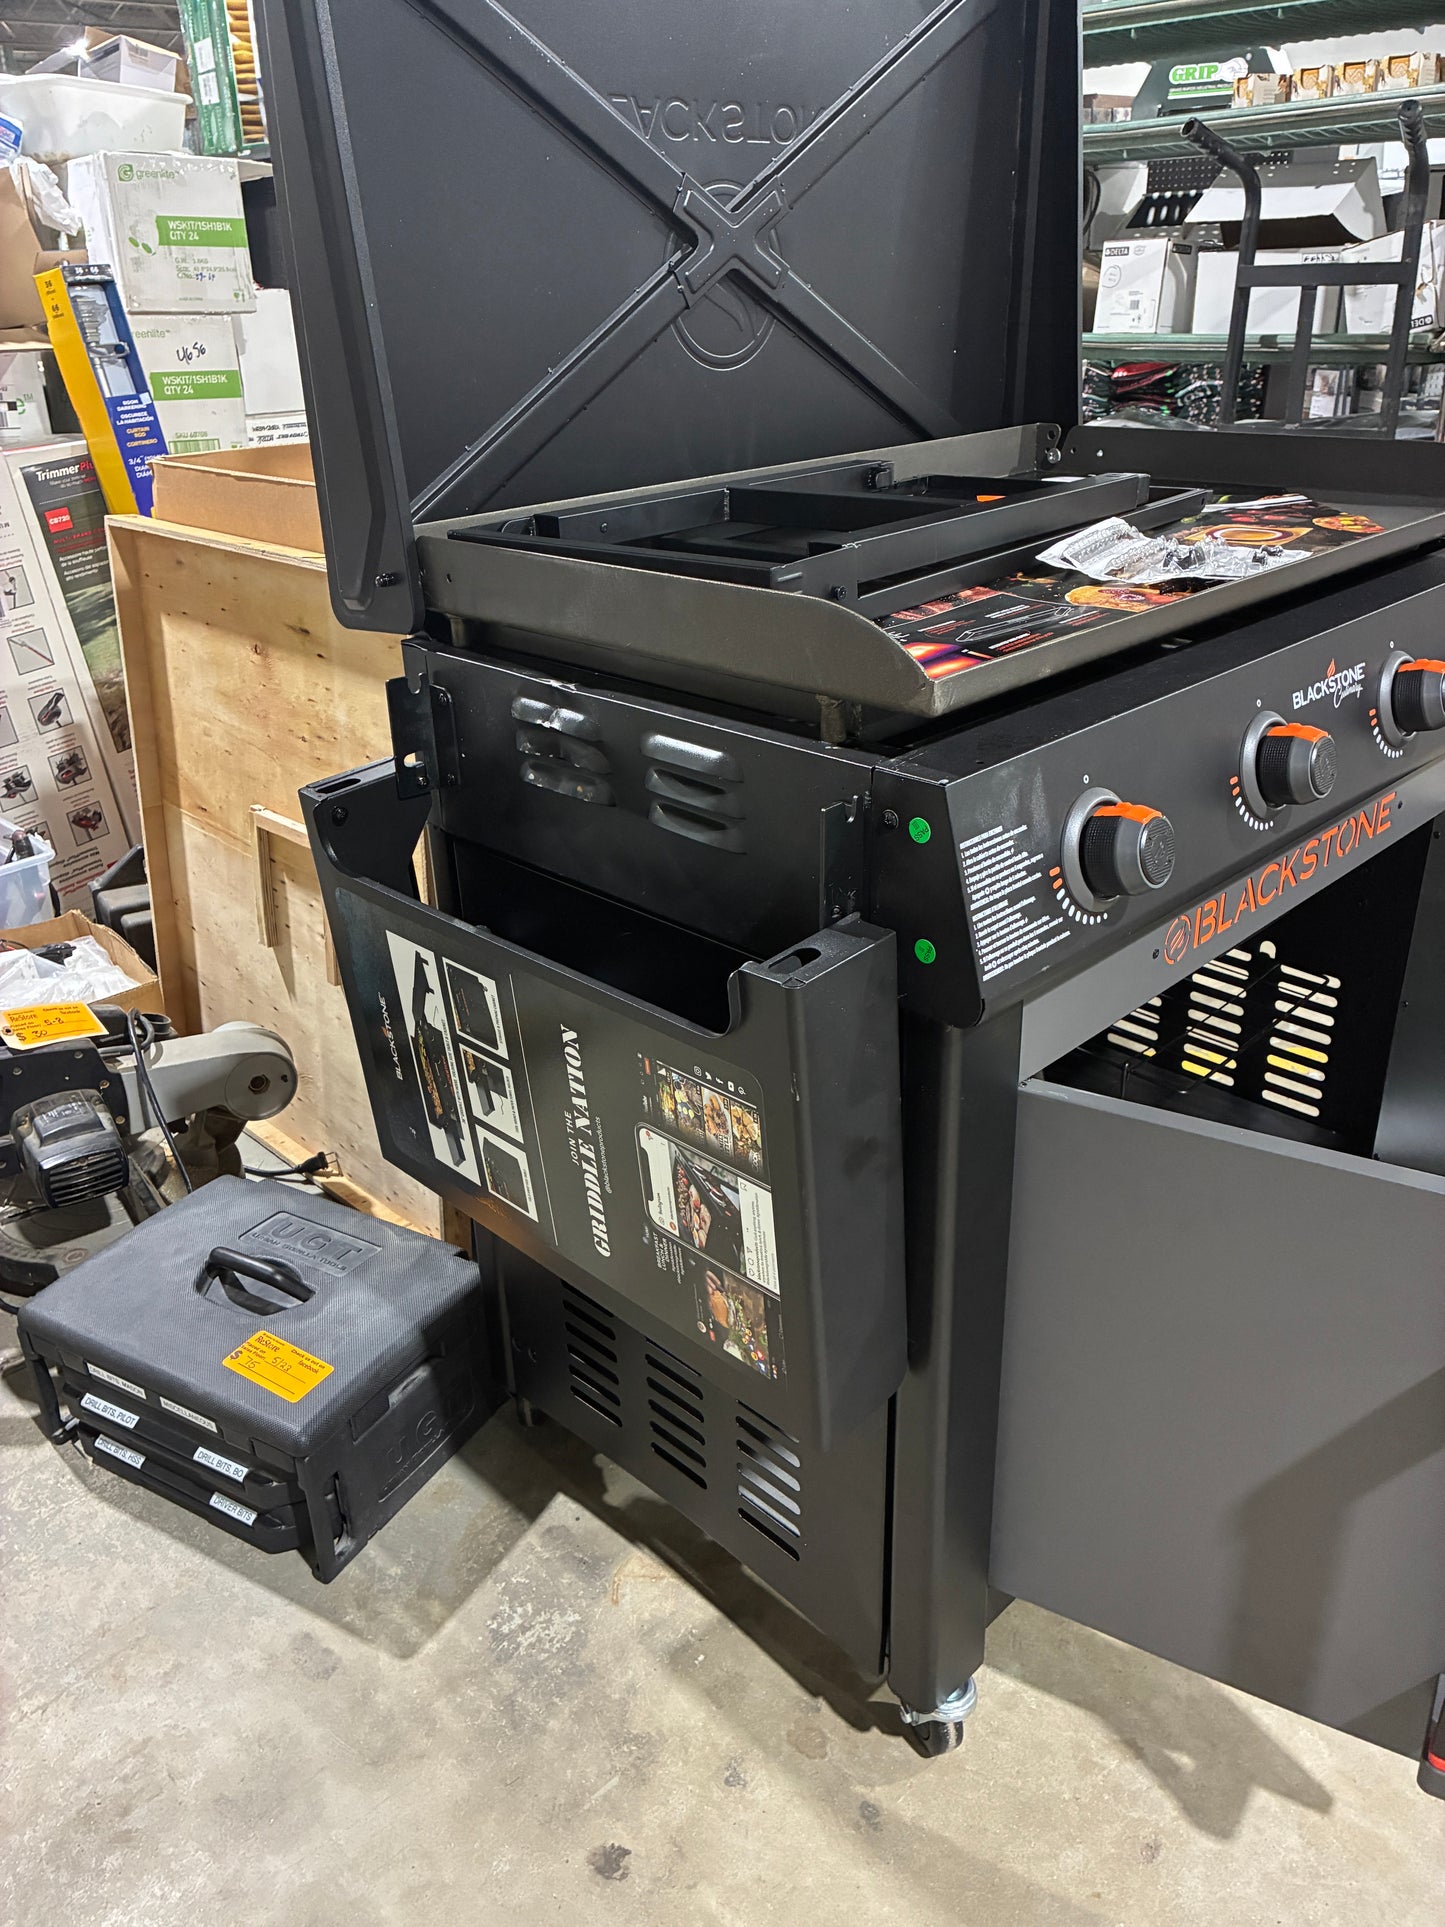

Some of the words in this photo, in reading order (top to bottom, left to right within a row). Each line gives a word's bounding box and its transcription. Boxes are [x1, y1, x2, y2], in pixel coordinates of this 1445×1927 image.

[1172, 64, 1219, 82] GRIP
[170, 231, 186, 241] QTY
[188, 231, 199, 240] 24
[1110, 247, 1128, 256] DELTA
[164, 386, 181, 395] QTY
[182, 385, 194, 395] 24
[1292, 662, 1366, 710] BLACKSTONE
[1193, 792, 1397, 949] BLACKSTONE
[9, 1013, 38, 1023] ReStore
[16, 1031, 27, 1042] $
[377, 991, 404, 1081] BLACKSTONE
[560, 1023, 593, 1136] NATION
[564, 1110, 575, 1134] THE
[568, 1137, 580, 1166] JOIN
[578, 1138, 611, 1258] GRIDDLE
[270, 1221, 363, 1261] UGT
[653, 1232, 663, 1269] BREAKFAST
[255, 1336, 280, 1353] ReStore
[229, 1350, 243, 1360] $
[244, 1355, 262, 1369] 75
[84, 1397, 102, 1411] DRILL
[117, 1410, 136, 1426] PILOT
[97, 1438, 113, 1453] DRILL
[128, 1453, 142, 1465] HSS
[198, 1451, 216, 1466] DRILL
[232, 1466, 244, 1478] BO
[213, 1498, 237, 1514] DRIVER
[237, 1508, 253, 1521] BITS
